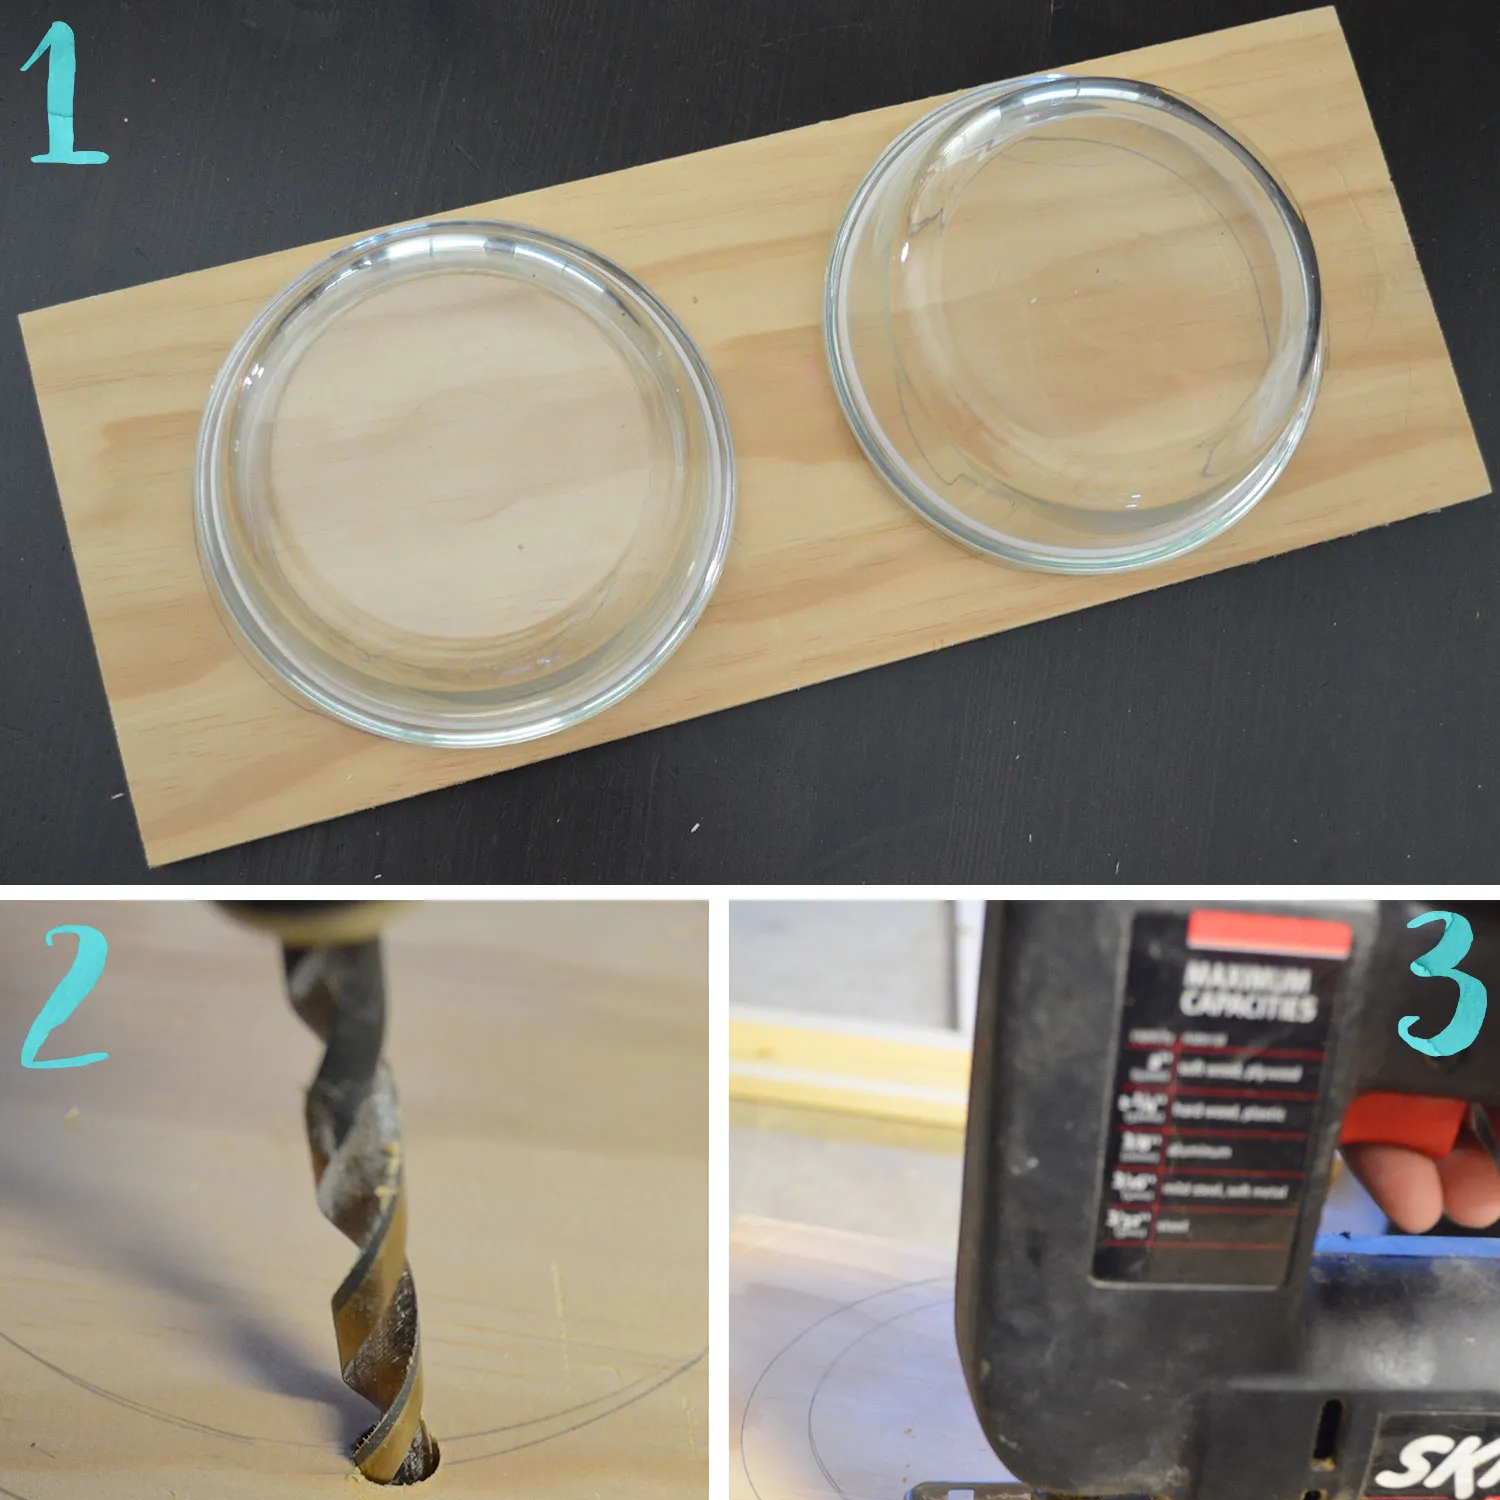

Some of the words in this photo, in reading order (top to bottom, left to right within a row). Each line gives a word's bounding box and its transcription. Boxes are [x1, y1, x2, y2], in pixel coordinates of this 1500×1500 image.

[1183, 960, 1312, 993] MAXIMUM
[1179, 989, 1318, 1023] CAPACITIES
[1167, 1142, 1233, 1160] aluminum
